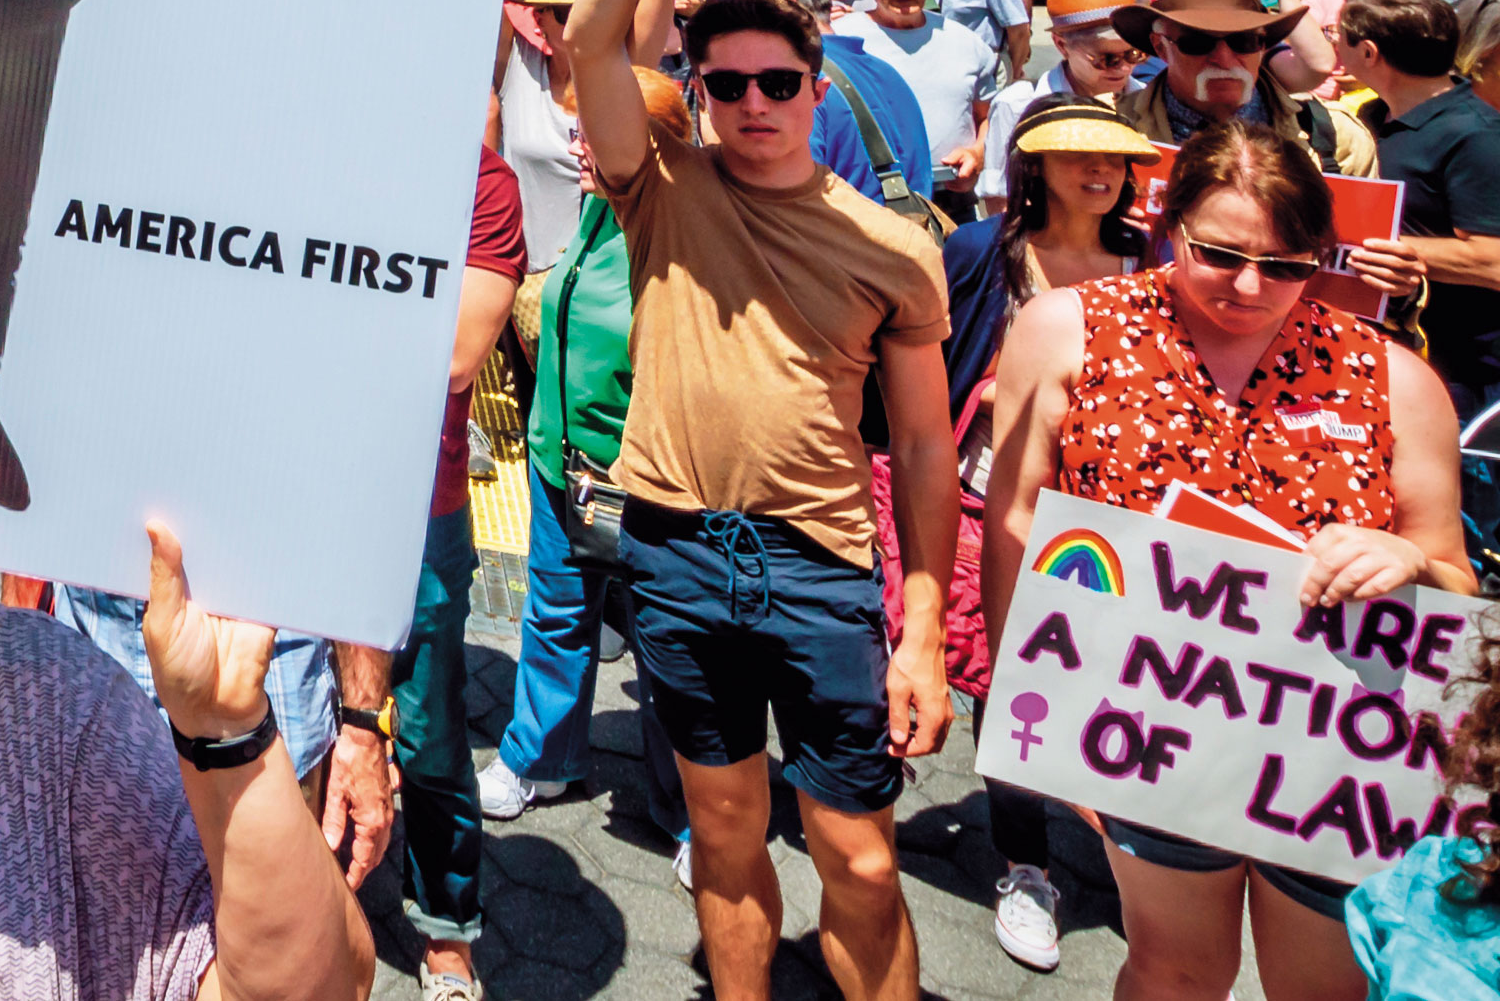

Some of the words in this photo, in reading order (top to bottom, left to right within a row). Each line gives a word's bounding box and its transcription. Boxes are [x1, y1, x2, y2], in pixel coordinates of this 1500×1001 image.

[55, 199, 284, 274] AMERICA
[301, 238, 449, 298] FIRST
[1018, 611, 1082, 671] A
[1150, 541, 1268, 634] WE
[1293, 598, 1465, 683] ARE
[1079, 703, 1192, 785] OF
